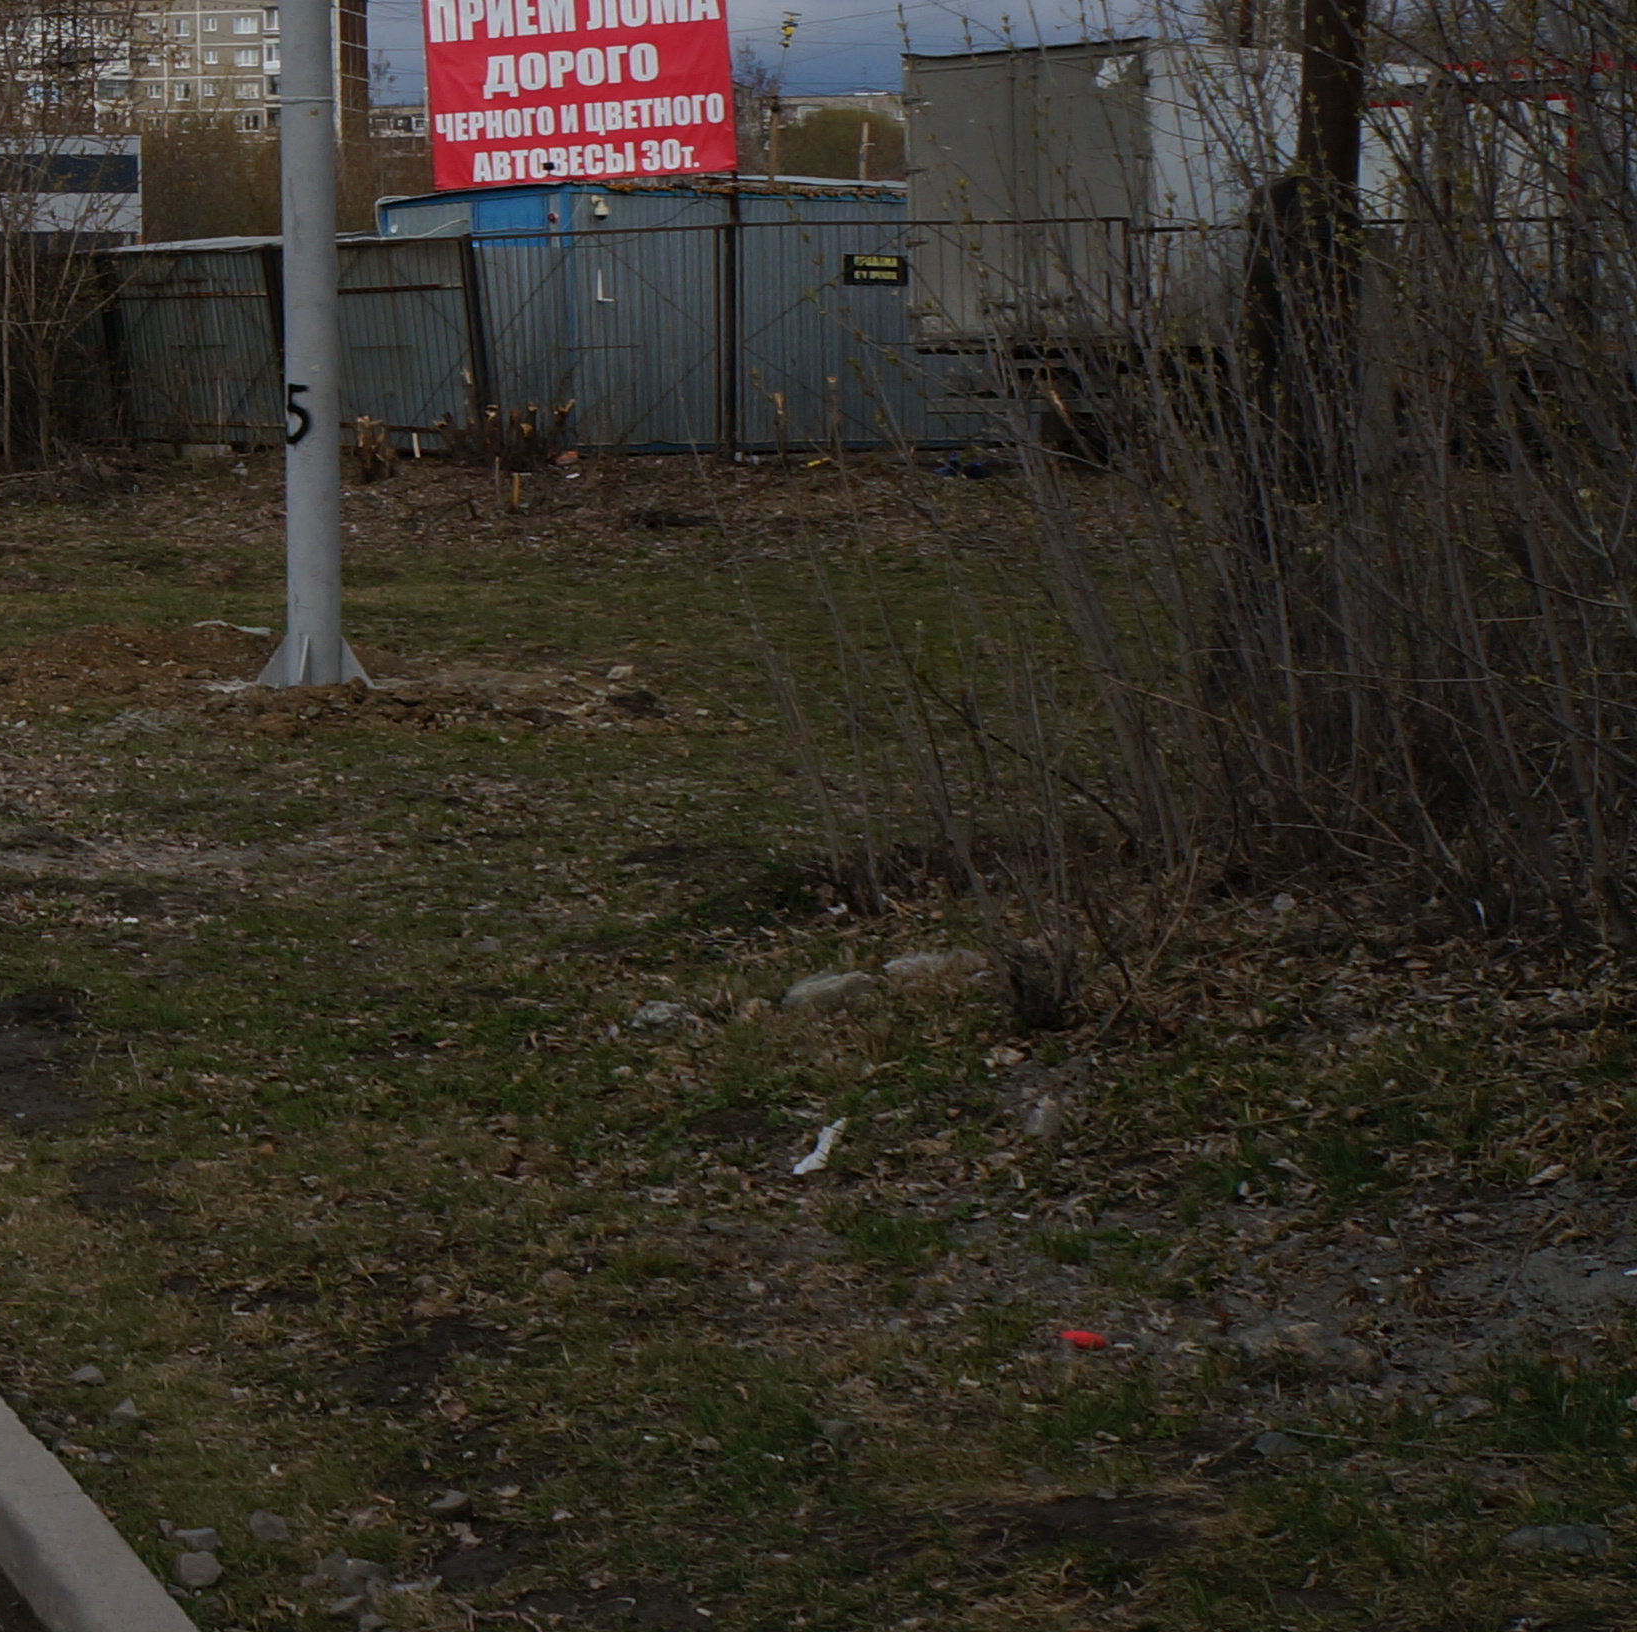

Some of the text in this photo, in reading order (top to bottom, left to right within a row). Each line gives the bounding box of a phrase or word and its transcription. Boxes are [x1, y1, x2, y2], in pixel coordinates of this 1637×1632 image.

[482, 42, 659, 100] ДОРОГО
[434, 91, 725, 143] ЧЕРНОГО И ЦВЕТНОГО
[472, 140, 637, 184] АВТОВЕСЫ
